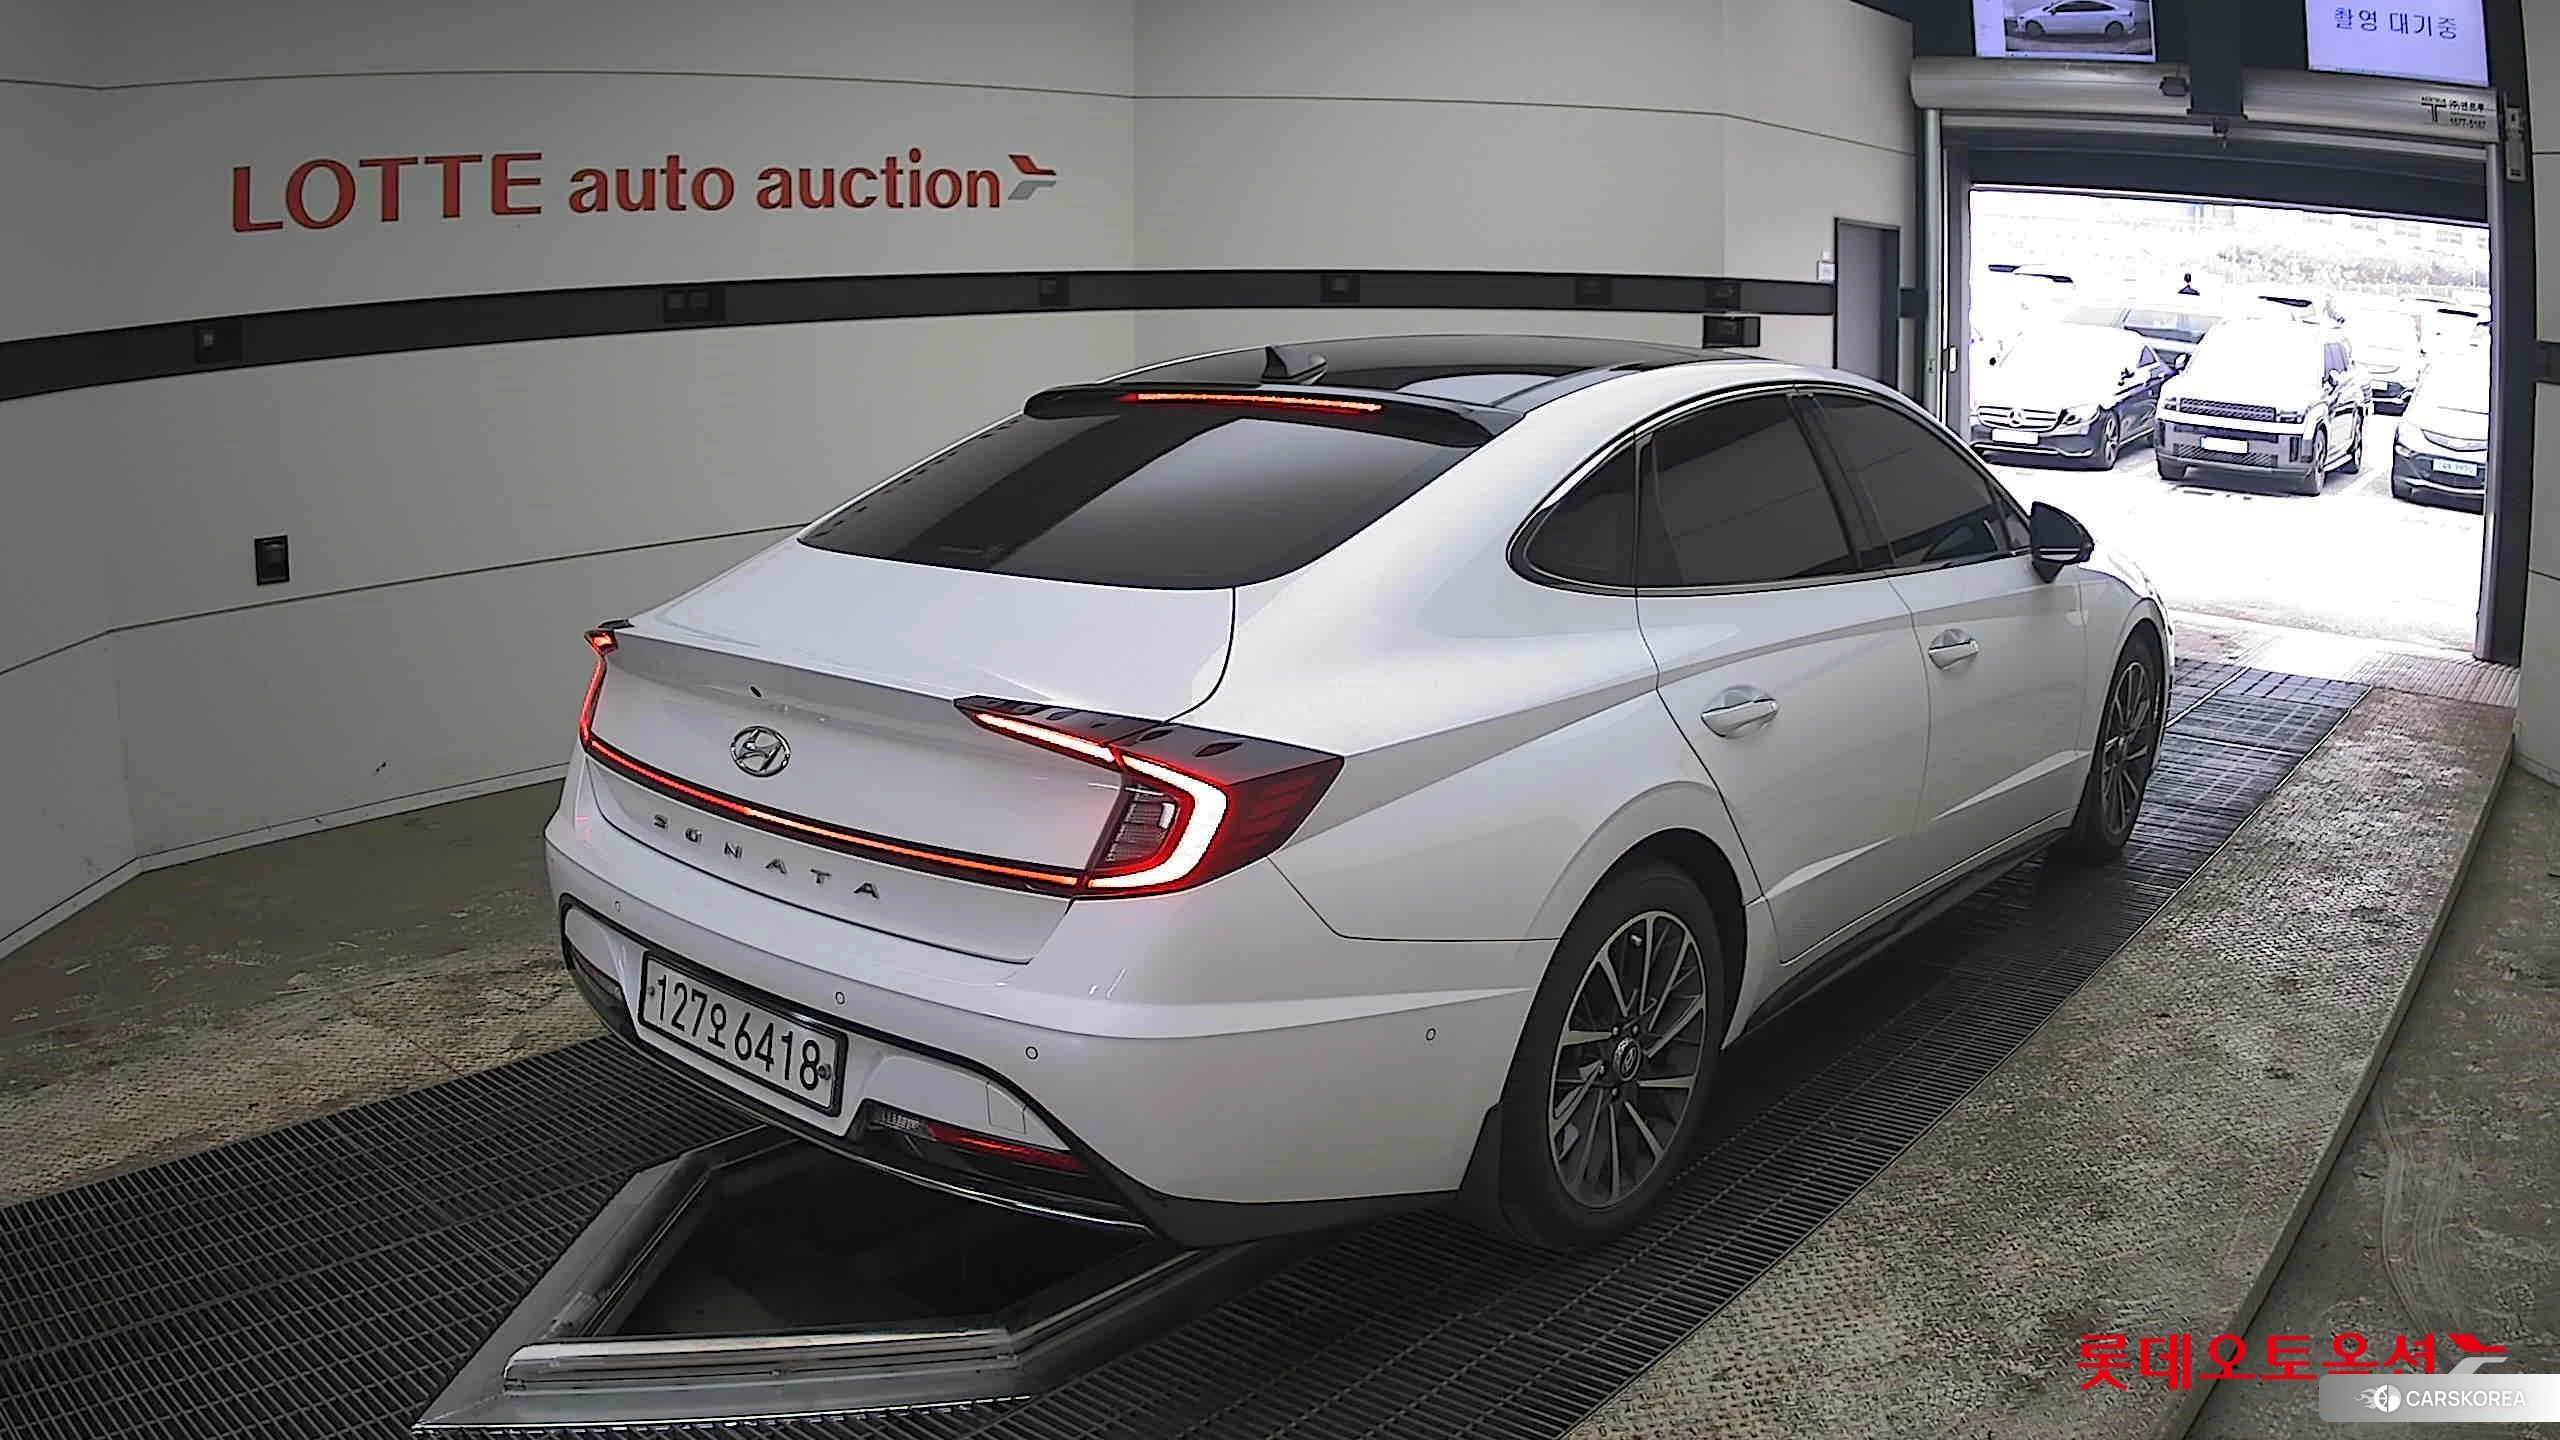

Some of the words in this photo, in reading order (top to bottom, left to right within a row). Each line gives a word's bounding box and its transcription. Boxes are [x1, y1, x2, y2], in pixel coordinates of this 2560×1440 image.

[2335, 7, 2378, 32] 촬영
[2389, 12, 2458, 40] 대기중
[232, 152, 543, 233] LOTTE
[568, 153, 736, 213] auto
[756, 146, 1001, 210] auction
[653, 813, 881, 900] SONATA
[656, 973, 821, 1092] 127오6418
